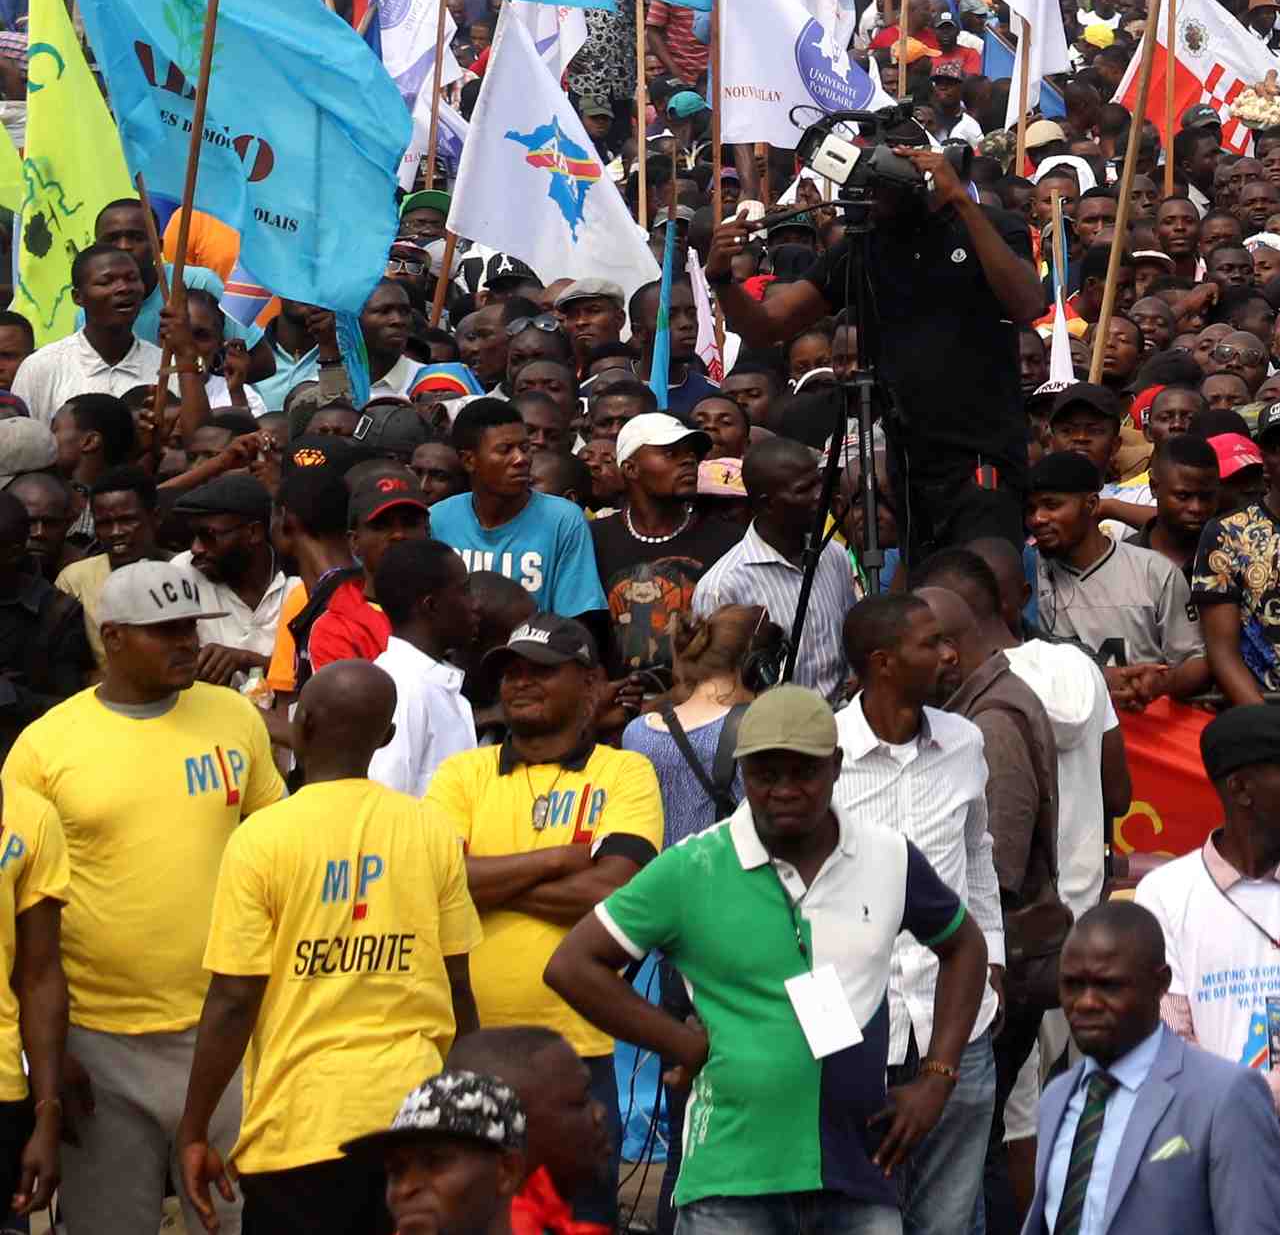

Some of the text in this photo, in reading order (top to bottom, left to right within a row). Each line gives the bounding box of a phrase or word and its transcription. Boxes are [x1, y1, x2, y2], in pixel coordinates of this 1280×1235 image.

[184, 745, 246, 806] MLP
[547, 782, 607, 845] MLP
[321, 851, 385, 920] MLP
[293, 931, 417, 977] SECURITE
